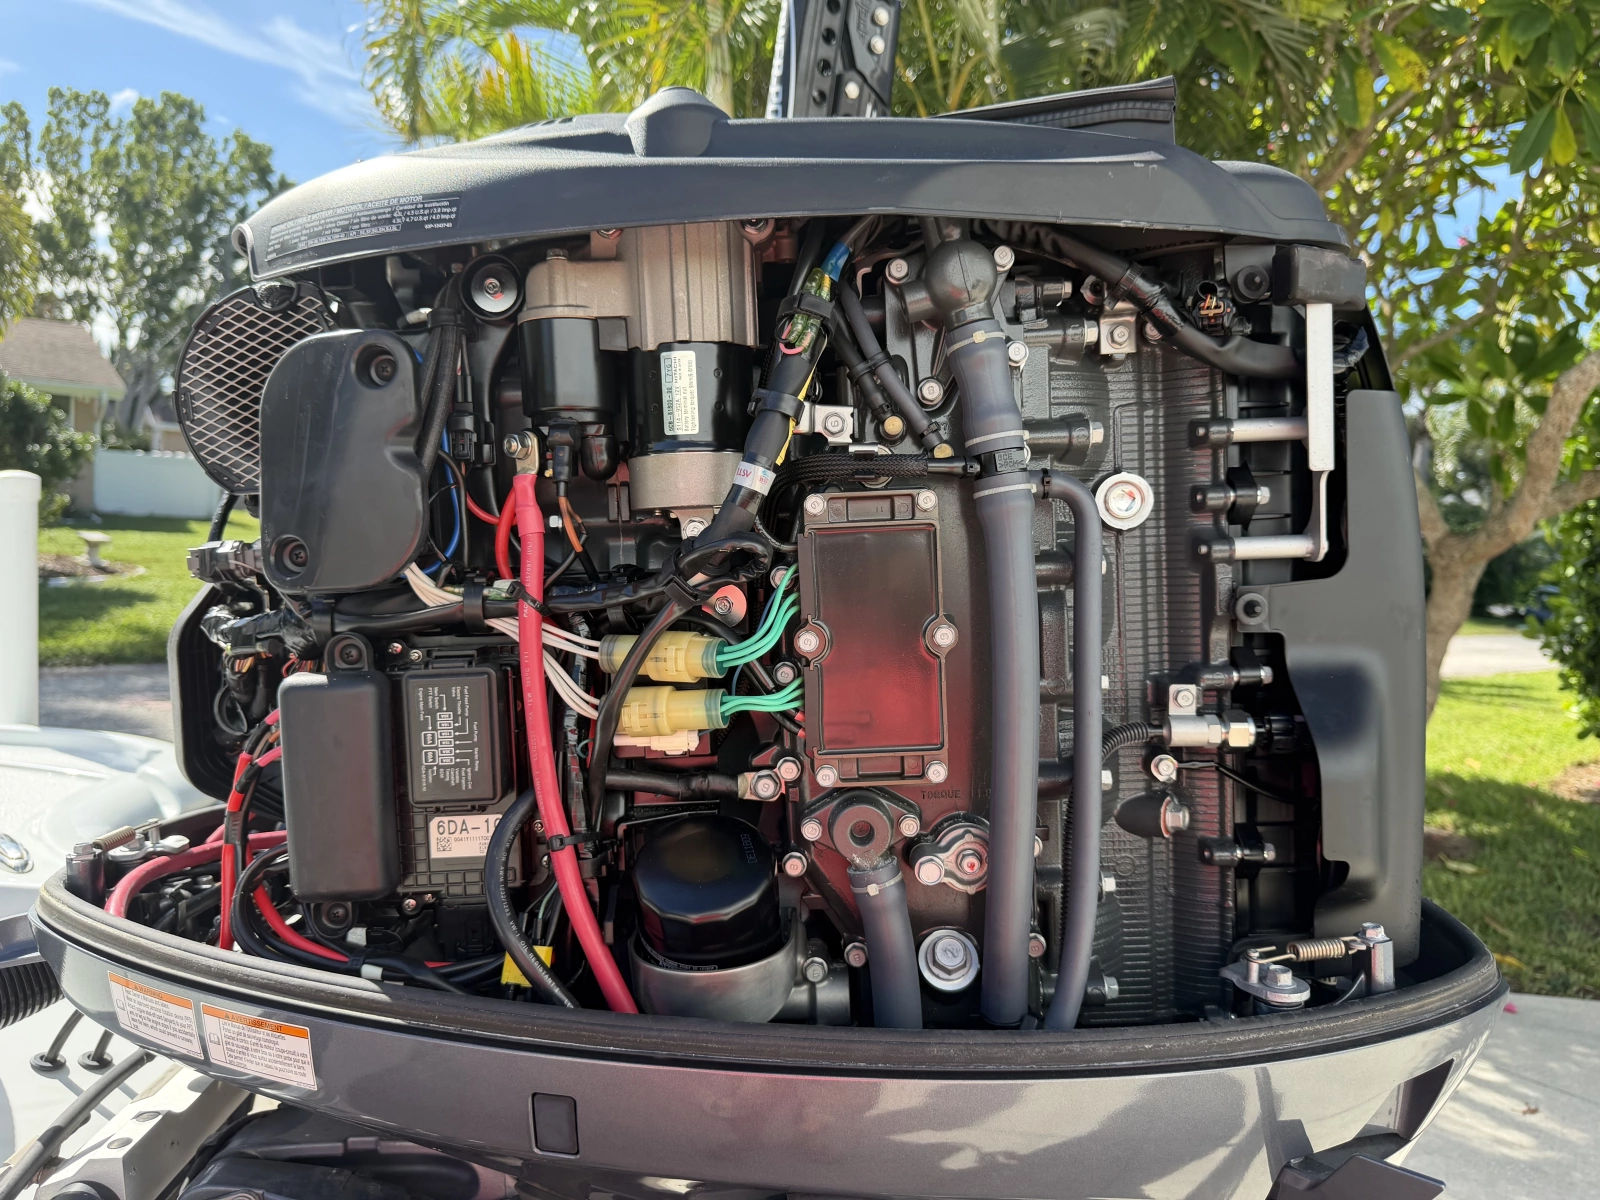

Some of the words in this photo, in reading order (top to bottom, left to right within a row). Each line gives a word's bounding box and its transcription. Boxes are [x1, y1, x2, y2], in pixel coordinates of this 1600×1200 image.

[368, 200, 389, 208] ACEITE
[400, 196, 423, 204] MOTOR
[920, 790, 962, 800] TORQUE
[501, 852, 507, 861] OR
[520, 941, 529, 953] OIL
[527, 953, 555, 987] RESISTANT
[231, 1014, 282, 1031] AVERTISSEMENT
